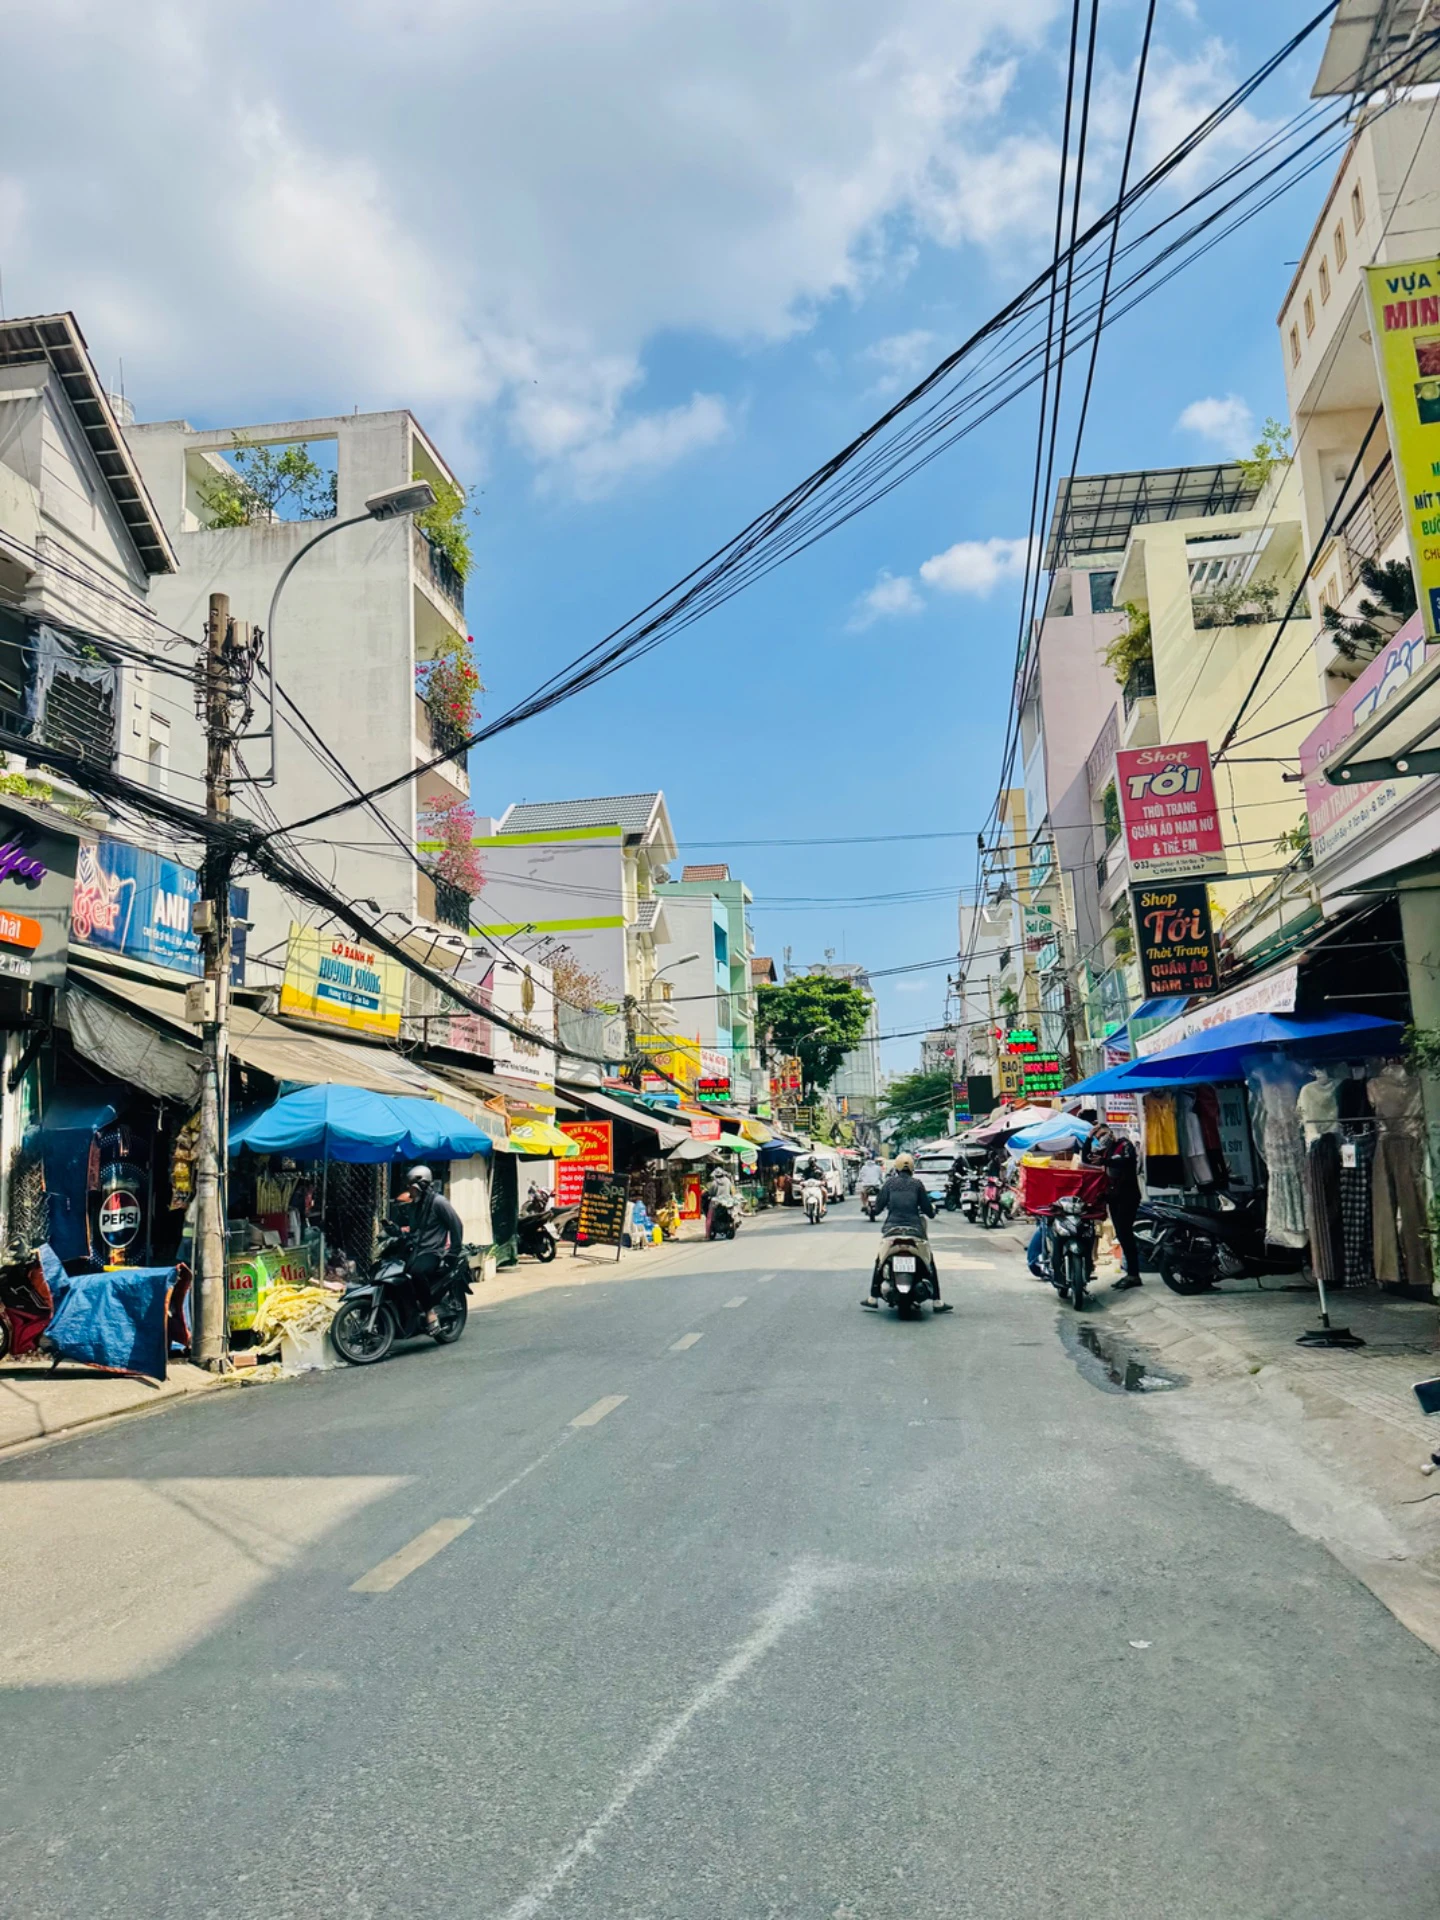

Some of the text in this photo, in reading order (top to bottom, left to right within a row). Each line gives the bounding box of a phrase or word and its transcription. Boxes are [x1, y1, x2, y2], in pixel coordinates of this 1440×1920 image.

[1386, 272, 1432, 296] VỰA
[1136, 750, 1191, 766] Shop
[1127, 764, 1202, 801] TỚI
[1142, 801, 1198, 819] THỜI TRANG
[1160, 821, 1174, 836] ÁO
[1174, 819, 1198, 834] NAM
[1152, 842, 1160, 856] &
[1140, 892, 1177, 908] Shop
[154, 888, 190, 933] ANH
[1143, 908, 1206, 944] Tới
[1146, 944, 1209, 960] Thời Trang
[1151, 979, 1182, 993] NAM
[1001, 1060, 1018, 1074] BAO
[583, 1126, 609, 1144] BEAUTY
[600, 1181, 624, 1199] Spa
[102, 1212, 138, 1226] PEPSI
